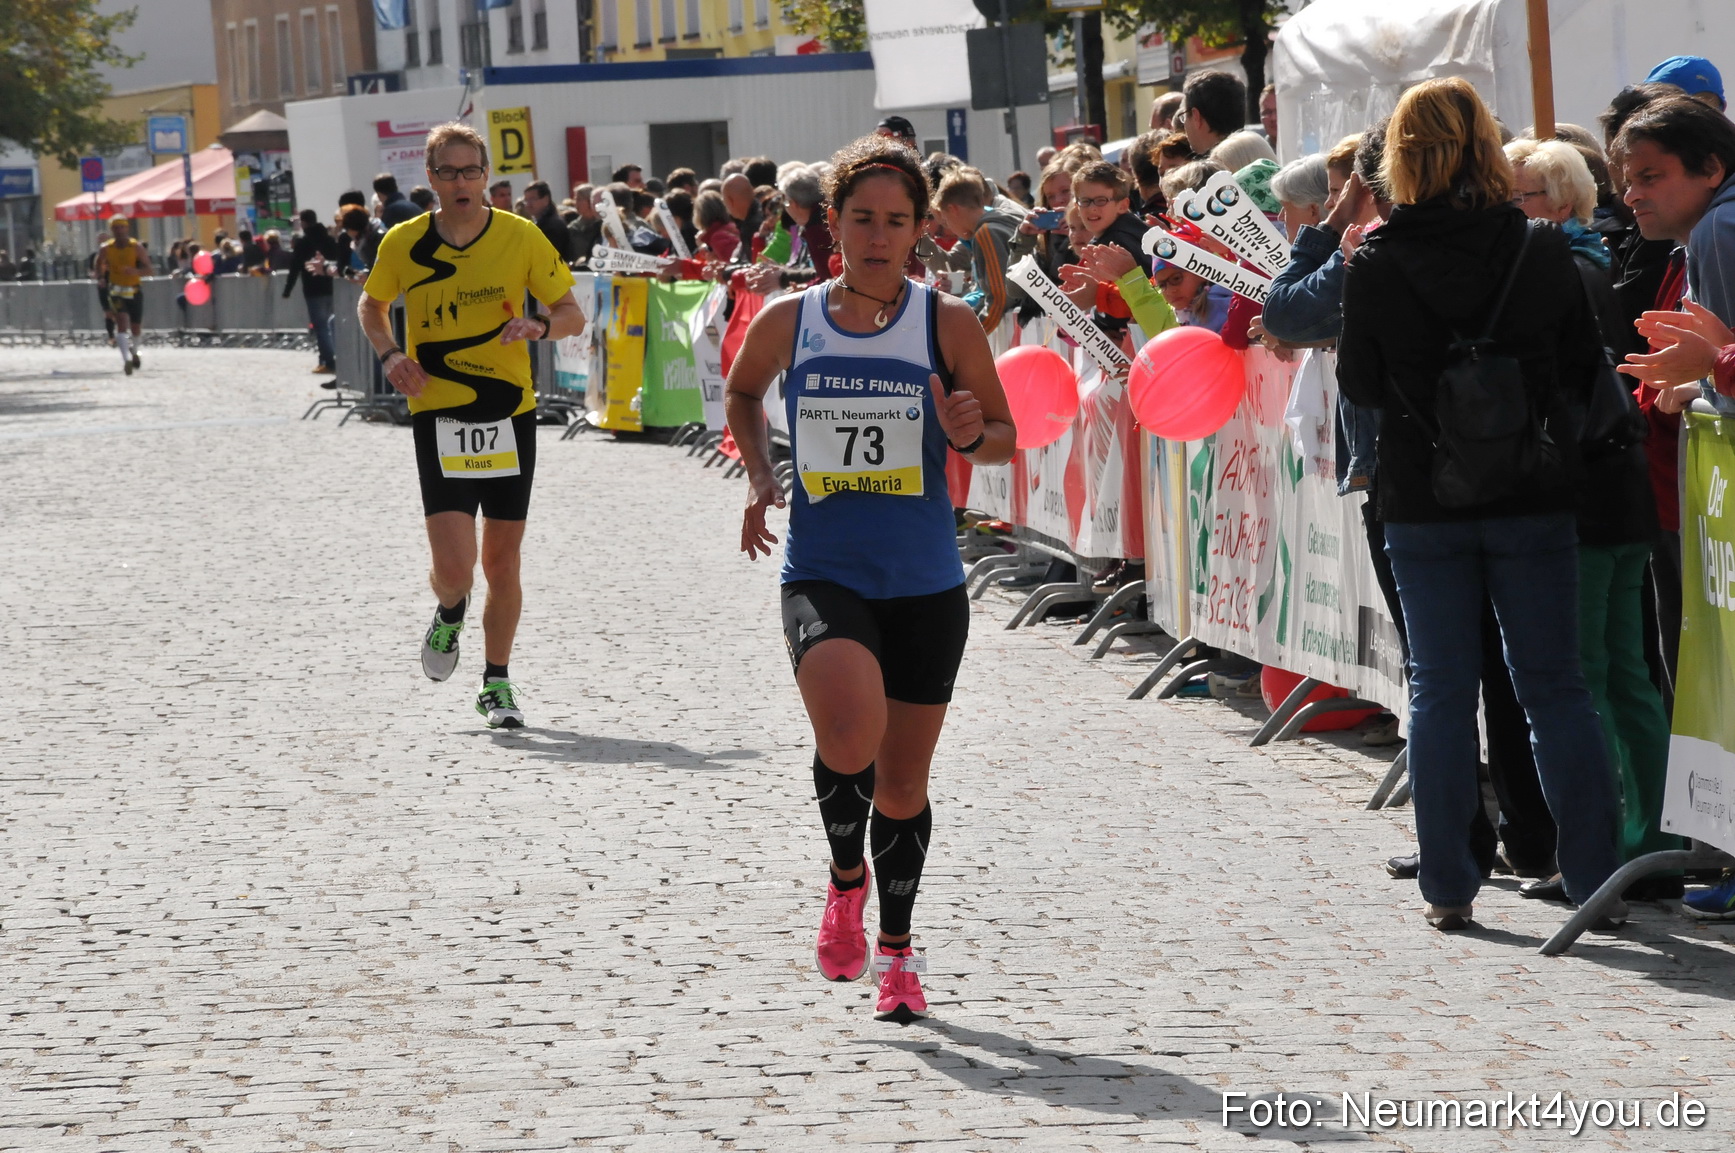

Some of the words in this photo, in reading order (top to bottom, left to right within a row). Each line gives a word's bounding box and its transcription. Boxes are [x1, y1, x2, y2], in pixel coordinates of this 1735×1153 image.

[492, 111, 526, 124] Block
[500, 128, 524, 160] D
[458, 285, 505, 301] Triathlon
[802, 327, 826, 353] LG
[824, 375, 864, 391] TELIS
[869, 379, 924, 397] FINANZ
[799, 409, 839, 421] PARTL
[841, 409, 901, 420] Neumarkt
[454, 425, 499, 454] 107
[835, 425, 885, 467] 73
[464, 459, 493, 469] Klaus
[822, 475, 902, 493] Eva-Maria
[1707, 465, 1728, 518] Der
[798, 620, 829, 643] LG
